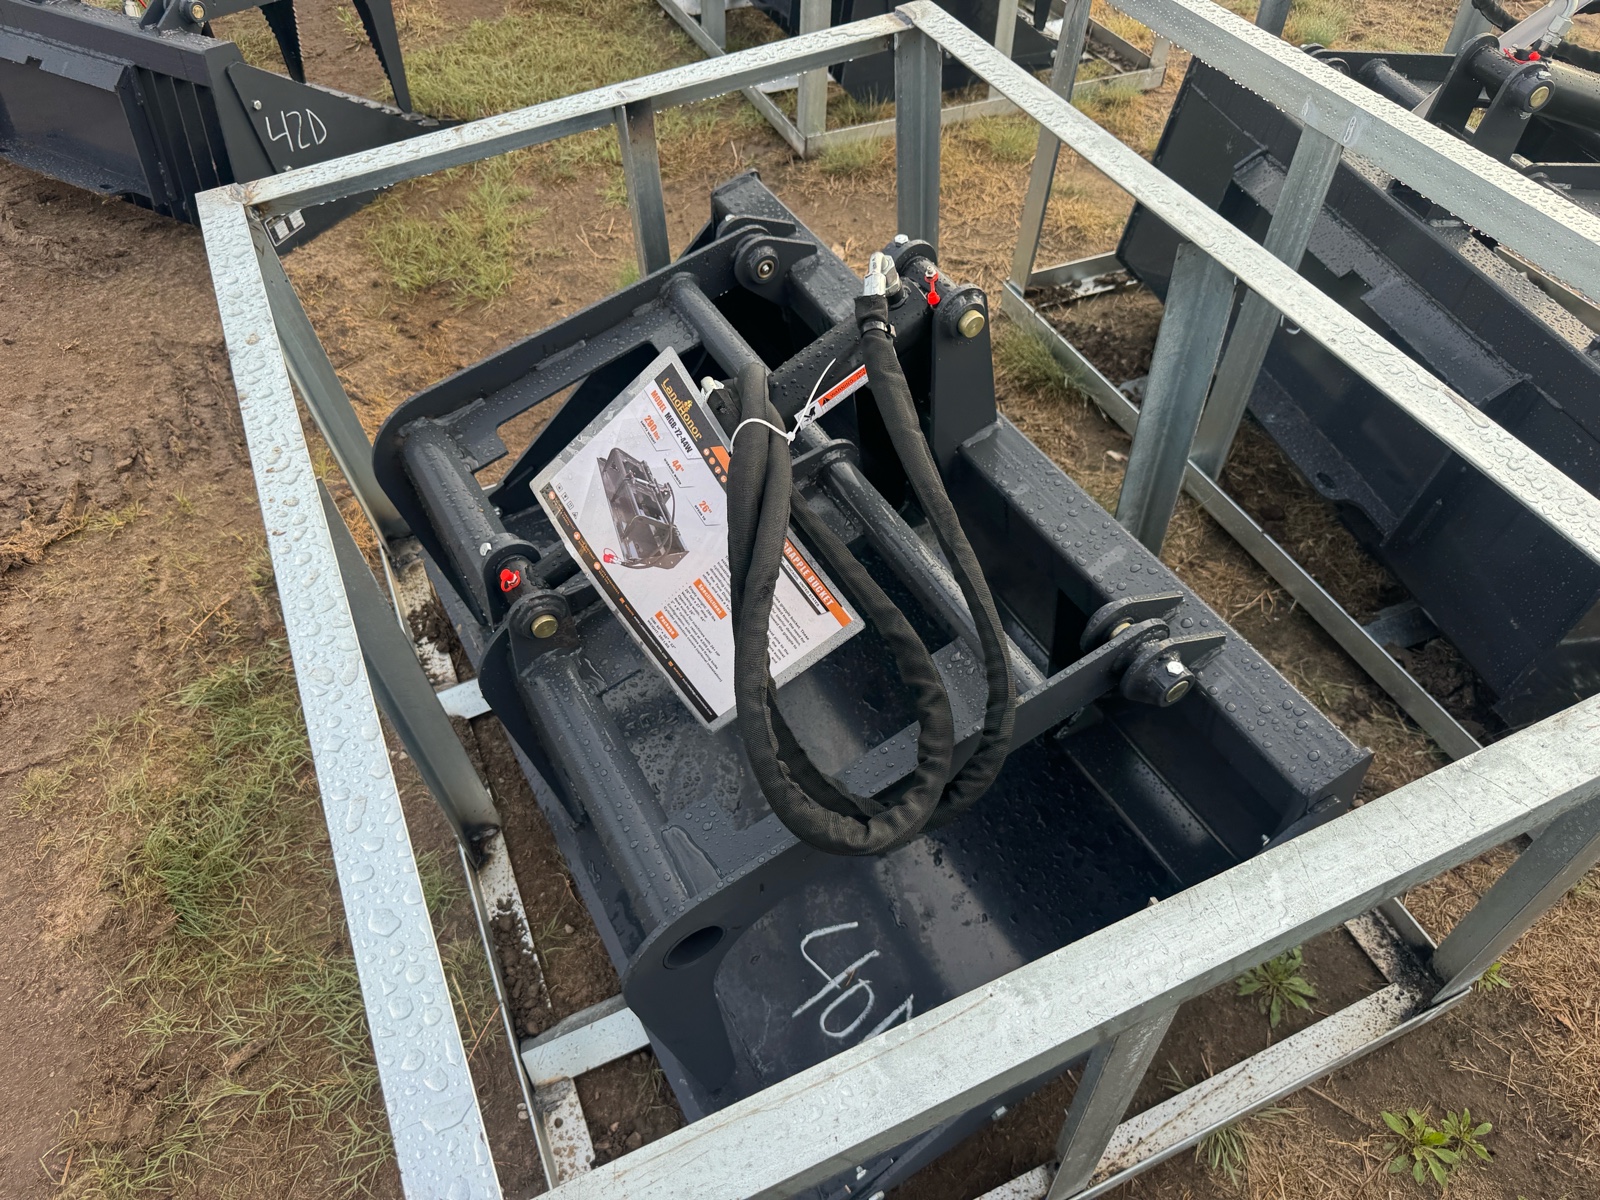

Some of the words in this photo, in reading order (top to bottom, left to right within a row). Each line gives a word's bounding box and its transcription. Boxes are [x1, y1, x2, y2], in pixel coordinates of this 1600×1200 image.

[650, 389, 667, 413] MODEL
[660, 376, 705, 440] LandHonor
[643, 414, 657, 433] 290
[671, 457, 684, 474] 44"
[698, 499, 712, 516] 26"
[781, 540, 811, 576] GRAPPLE
[807, 574, 834, 606] BUCKET
[658, 614, 675, 635] Package
